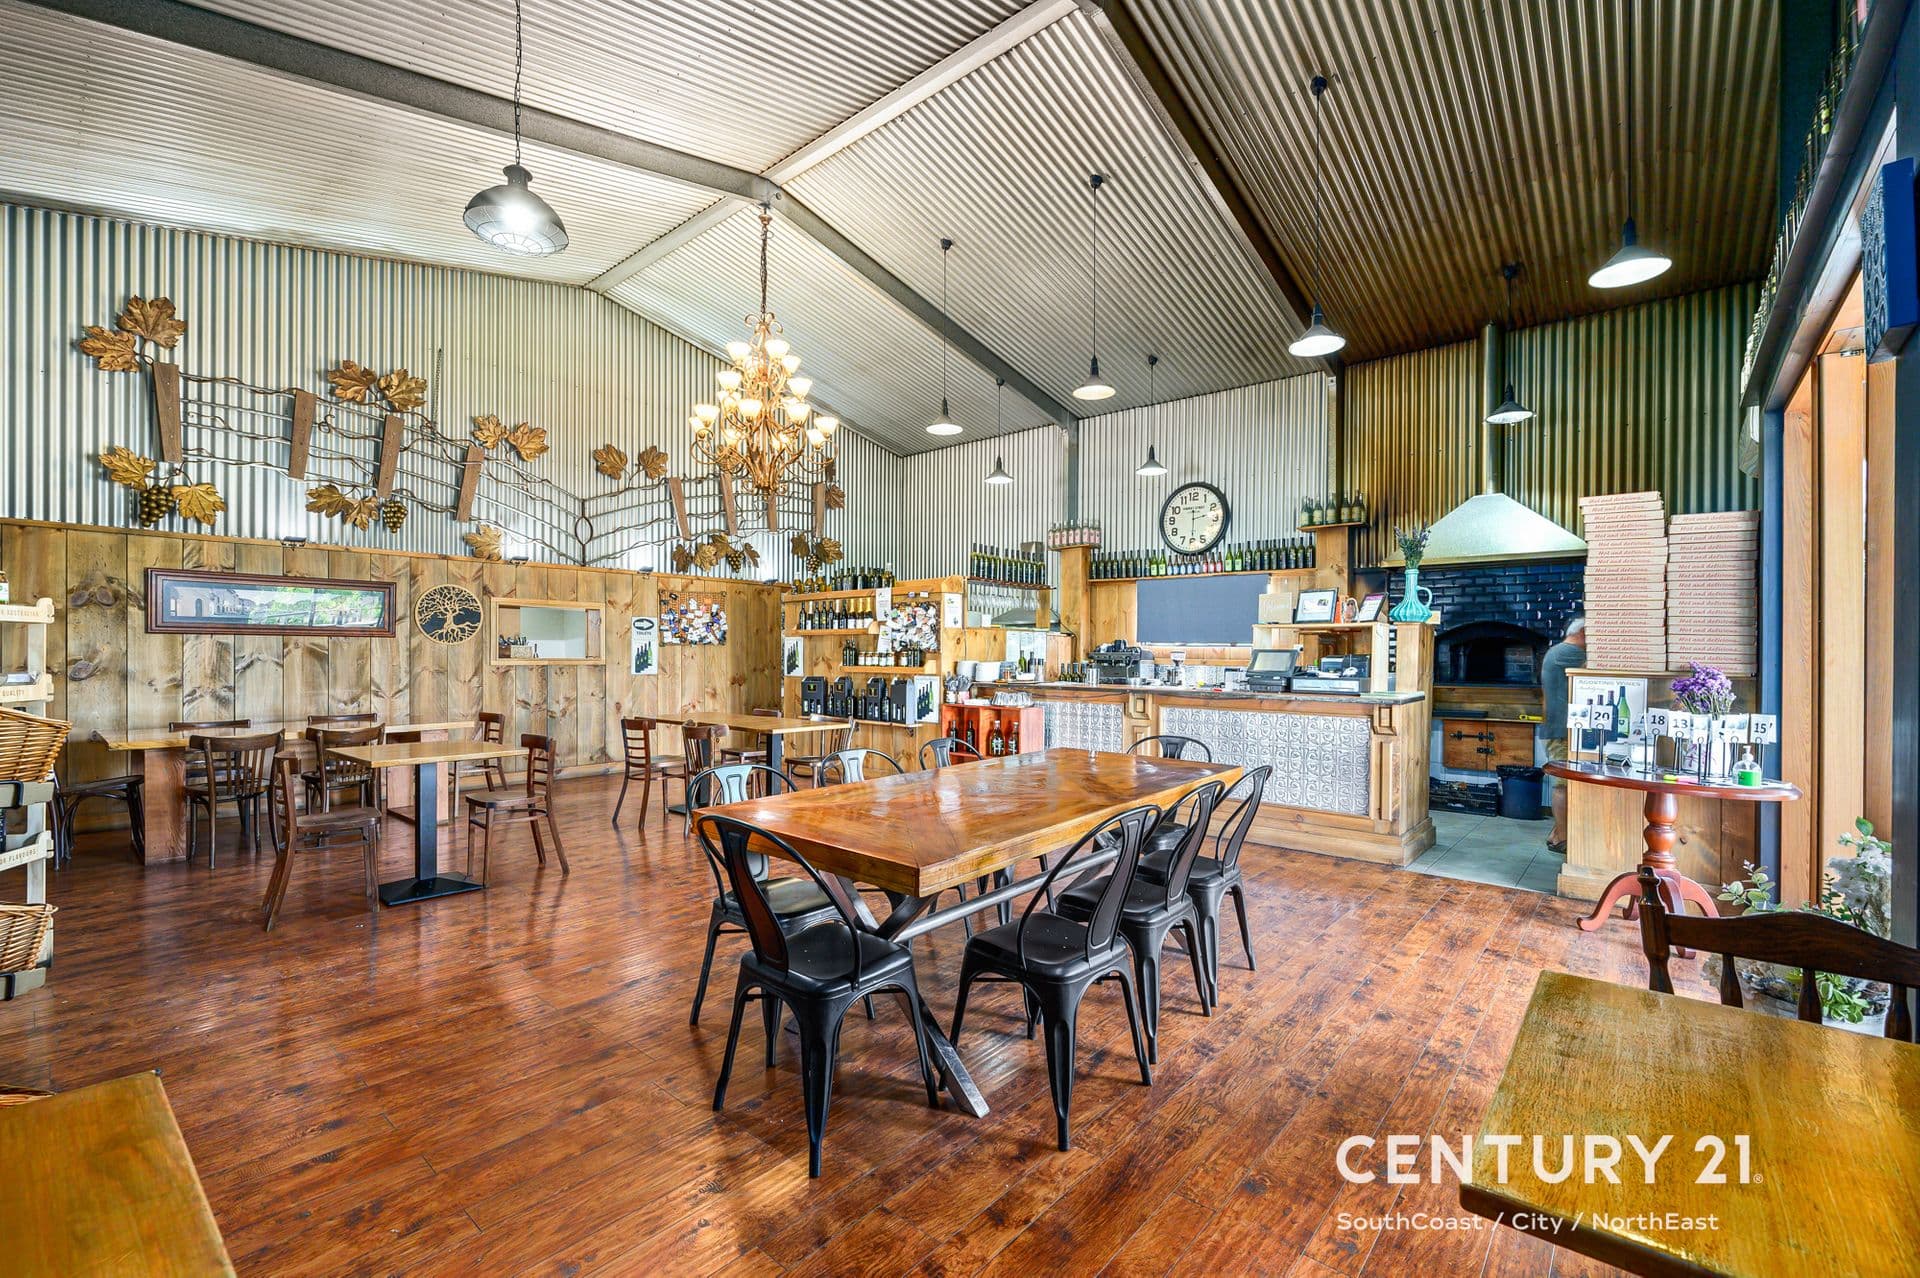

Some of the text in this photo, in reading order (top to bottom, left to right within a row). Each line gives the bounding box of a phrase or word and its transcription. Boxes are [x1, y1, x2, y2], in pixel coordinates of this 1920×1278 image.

[1189, 492, 1199, 501] 12
[1172, 506, 1180, 514] 10
[1172, 528, 1177, 536] 8
[1651, 715, 1665, 725] 18
[1673, 719, 1688, 728] 13
[1754, 722, 1766, 733] 15
